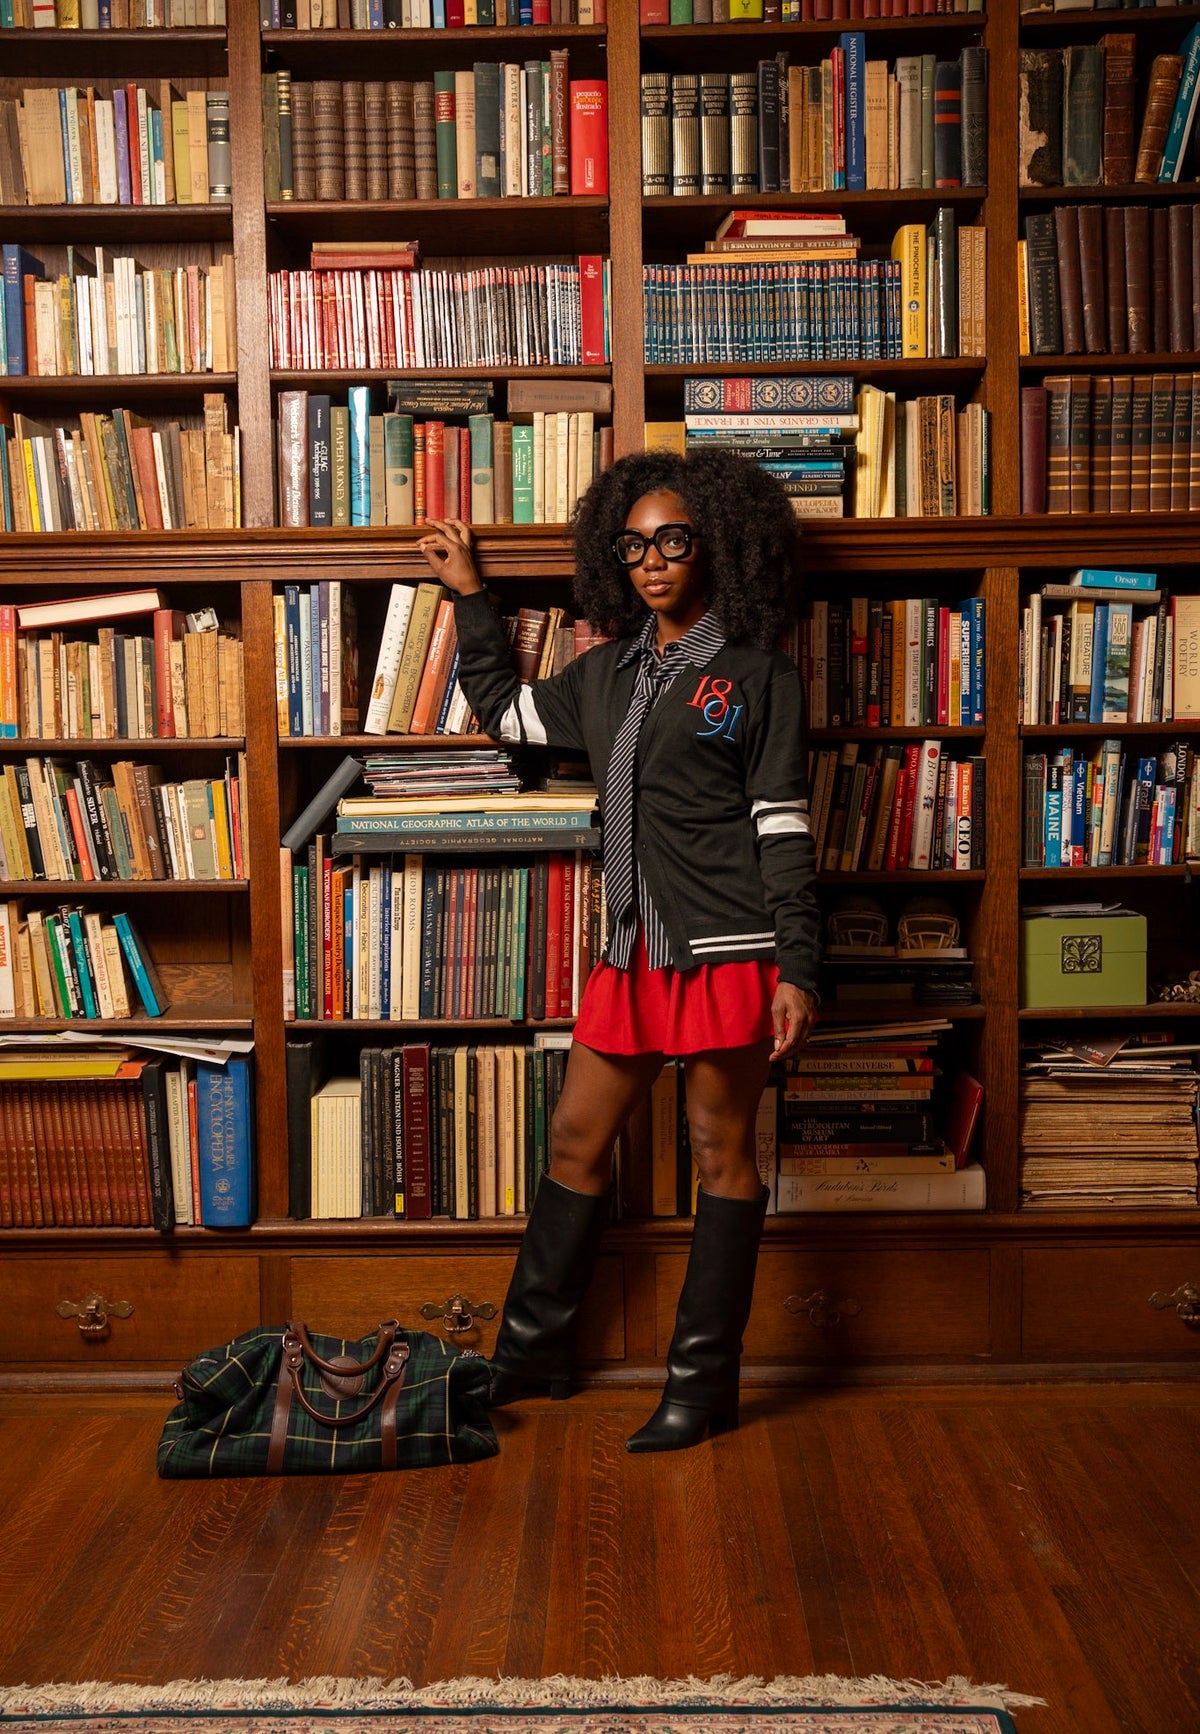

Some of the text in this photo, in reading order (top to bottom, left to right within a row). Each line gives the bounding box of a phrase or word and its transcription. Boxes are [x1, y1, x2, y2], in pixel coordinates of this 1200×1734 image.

[72, 144, 78, 152] DE
[731, 242, 791, 250] MANUALIDADES
[290, 399, 301, 526] Webster's New Collegiate Dictionary
[313, 441, 321, 476] Archipelago
[336, 427, 344, 502] PAPER MONEY
[1114, 575, 1138, 586] Orsay
[392, 602, 399, 618] OF
[974, 619, 982, 632] you
[393, 605, 410, 672] ELEMENTS
[895, 621, 904, 652] SMART
[1114, 623, 1125, 635] 500
[402, 642, 414, 675] OF DOLLS
[402, 606, 430, 714] THE COLLECTOR'S ENCYCLOPEDIA
[912, 650, 920, 677] STARTUPS
[962, 620, 970, 695] SUPERFREAKONOMICS
[975, 648, 983, 668] What
[1083, 623, 1091, 676] LITERATURE
[1179, 638, 1187, 676] POETRY
[1189, 630, 1198, 676] WORLD
[816, 657, 825, 680] four
[870, 662, 879, 695] branding
[974, 668, 982, 682] you
[895, 669, 904, 708] LUCKY?
[912, 678, 920, 691] THAT
[926, 760, 937, 791] Boys
[940, 760, 948, 771] BIG
[962, 768, 970, 784] THE
[1177, 745, 1188, 782] LONDON
[135, 772, 146, 807] LATIN
[939, 773, 947, 797] BRANDS
[962, 785, 970, 804] ROAD
[1076, 781, 1085, 814] Vietnam
[1140, 780, 1152, 810] Brazil
[86, 797, 98, 824] SILVER
[94, 829, 102, 844] Holland
[351, 817, 567, 830] NATIONAL GEOGRAPHIC ATLAS OF THE WORLD
[880, 805, 891, 838] TRADING
[1048, 794, 1059, 841] MAINE
[891, 826, 900, 857] OPPORTUNITY
[958, 816, 970, 854] CEO
[334, 893, 342, 924] Antiques
[360, 883, 368, 919] Decorating
[408, 898, 416, 931] ROOMS
[61, 908, 70, 928] Zorro
[334, 932, 342, 957] Jewelry
[334, 959, 342, 985] Designs
[807, 1062, 895, 1070] CALDER'S UNIVERSE
[209, 1074, 223, 1171] ENCYCLOPEDIA
[225, 1076, 234, 1171] THE NEW COLUMBIA
[791, 1122, 851, 1130] METROPOLITAN
[816, 1181, 897, 1192] Audubon's Birds
